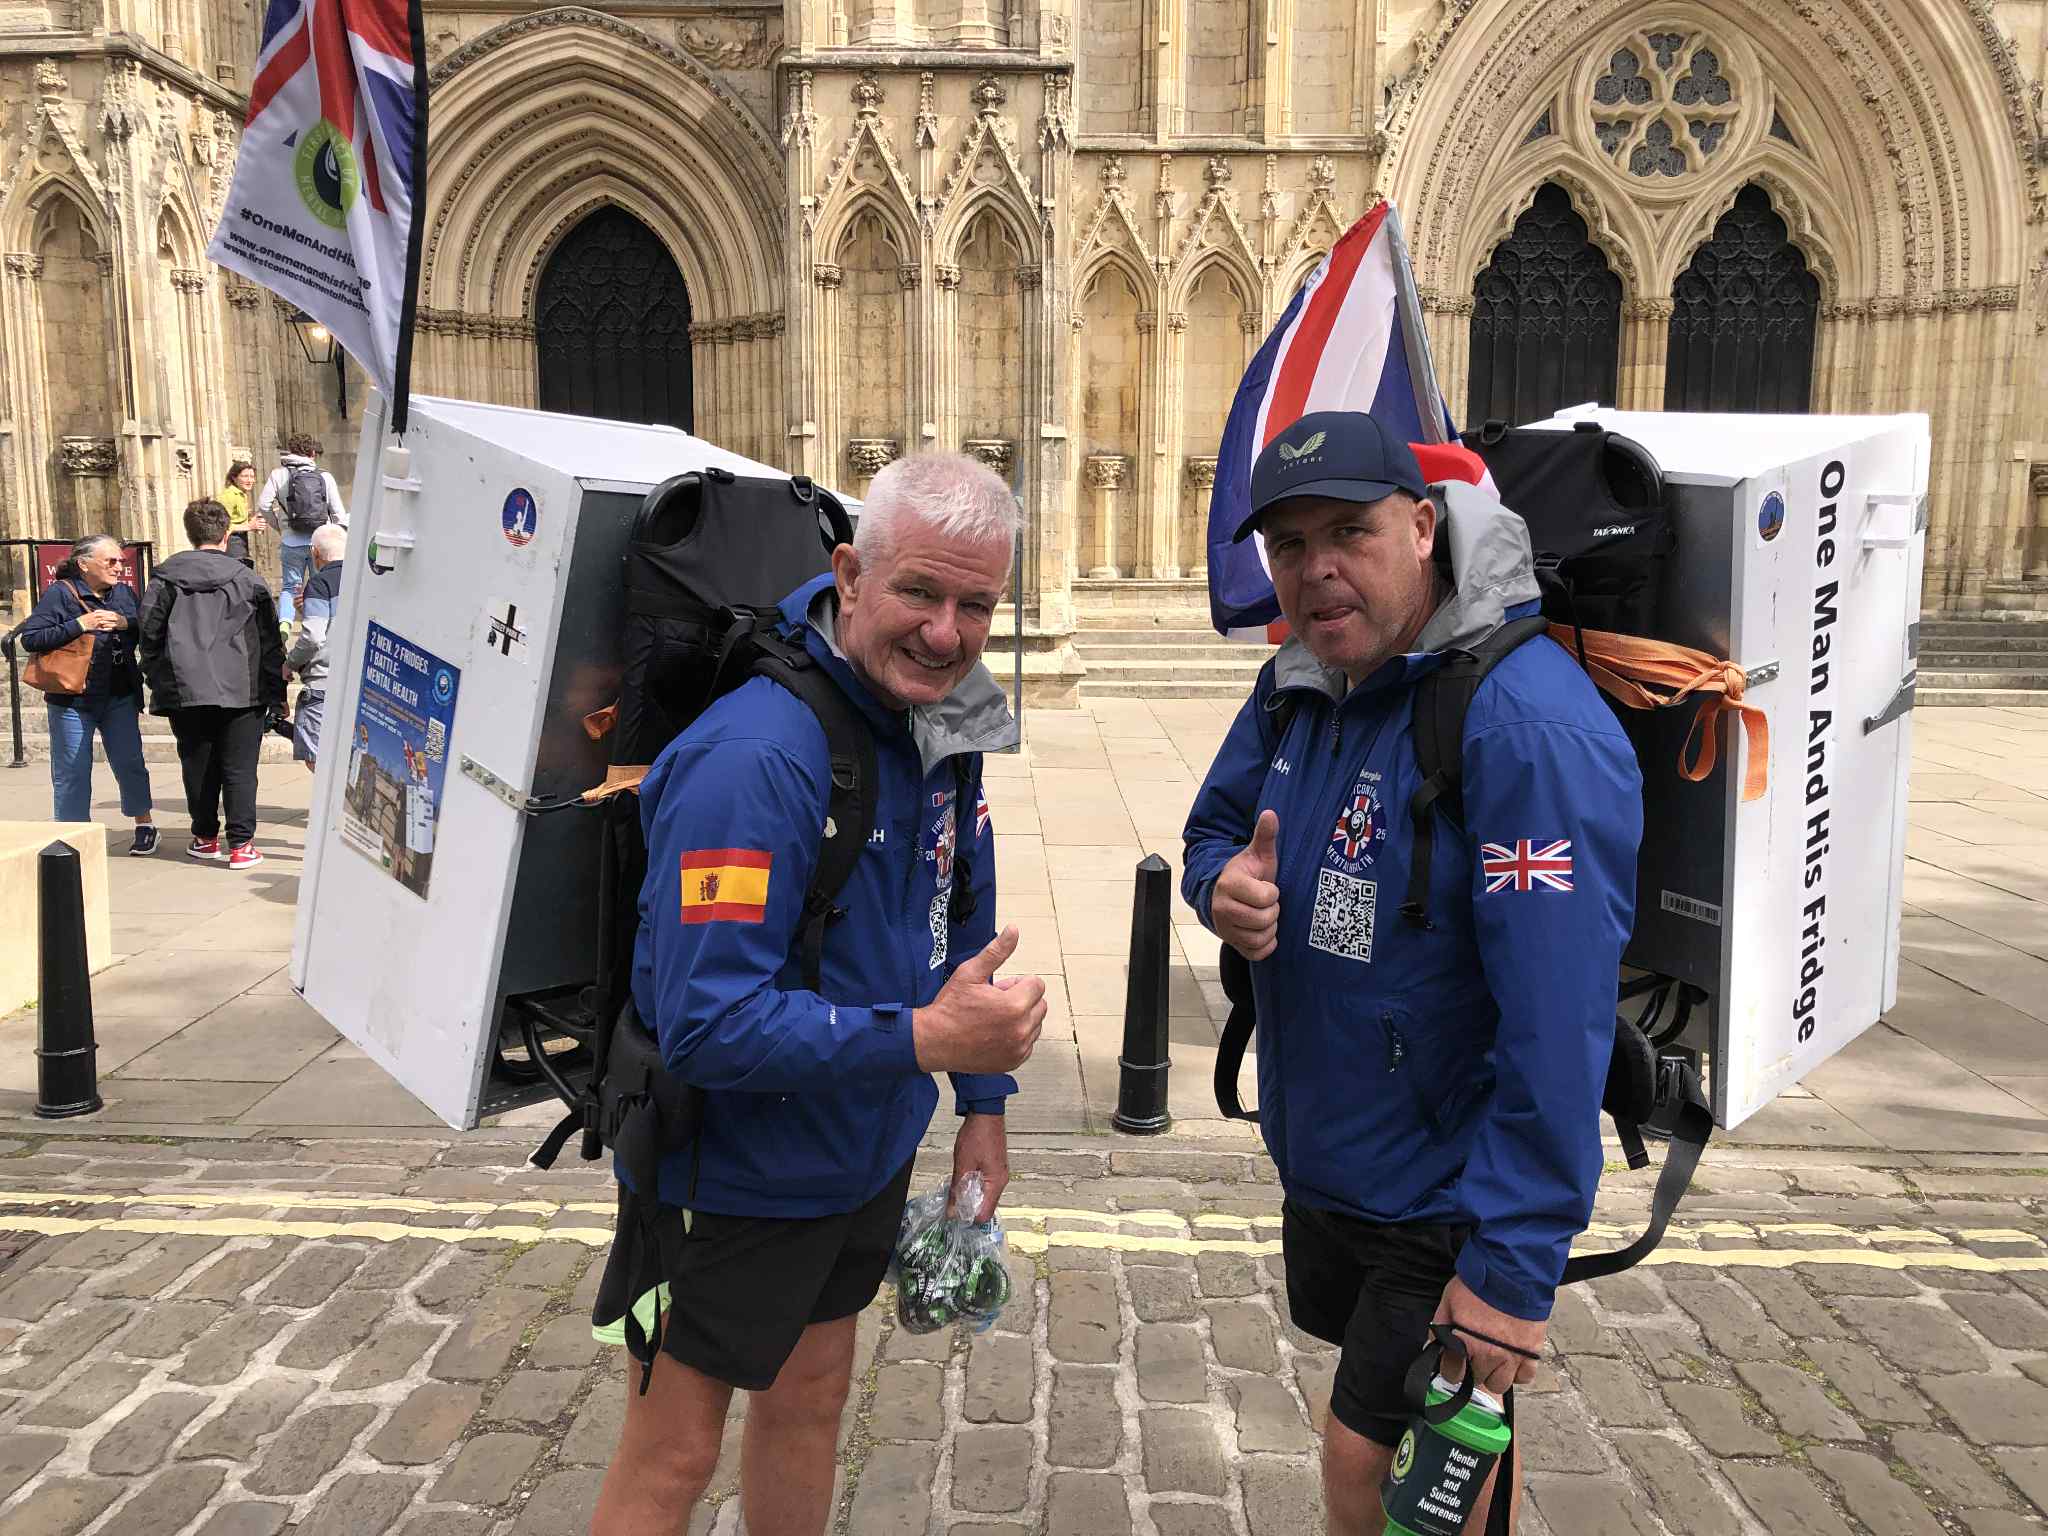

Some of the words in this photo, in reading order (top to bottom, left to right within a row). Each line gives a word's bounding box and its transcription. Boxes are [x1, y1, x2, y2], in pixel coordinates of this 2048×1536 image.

[1815, 459, 1846, 567] One
[370, 631, 377, 646] 2
[393, 643, 400, 659] 2
[1809, 580, 1839, 695] Man
[369, 649, 373, 663] 1
[366, 666, 391, 693] MENTAL
[392, 681, 418, 707] HEALTH
[1803, 710, 1832, 804] And
[1803, 808, 1830, 891] His
[1793, 893, 1825, 1045] Fridge
[1443, 1462, 1471, 1481] Health
[1448, 1447, 1480, 1469] Mental
[1429, 1487, 1461, 1508] Suicide
[1442, 1478, 1461, 1492] and
[1416, 1497, 1463, 1524] Awareness
